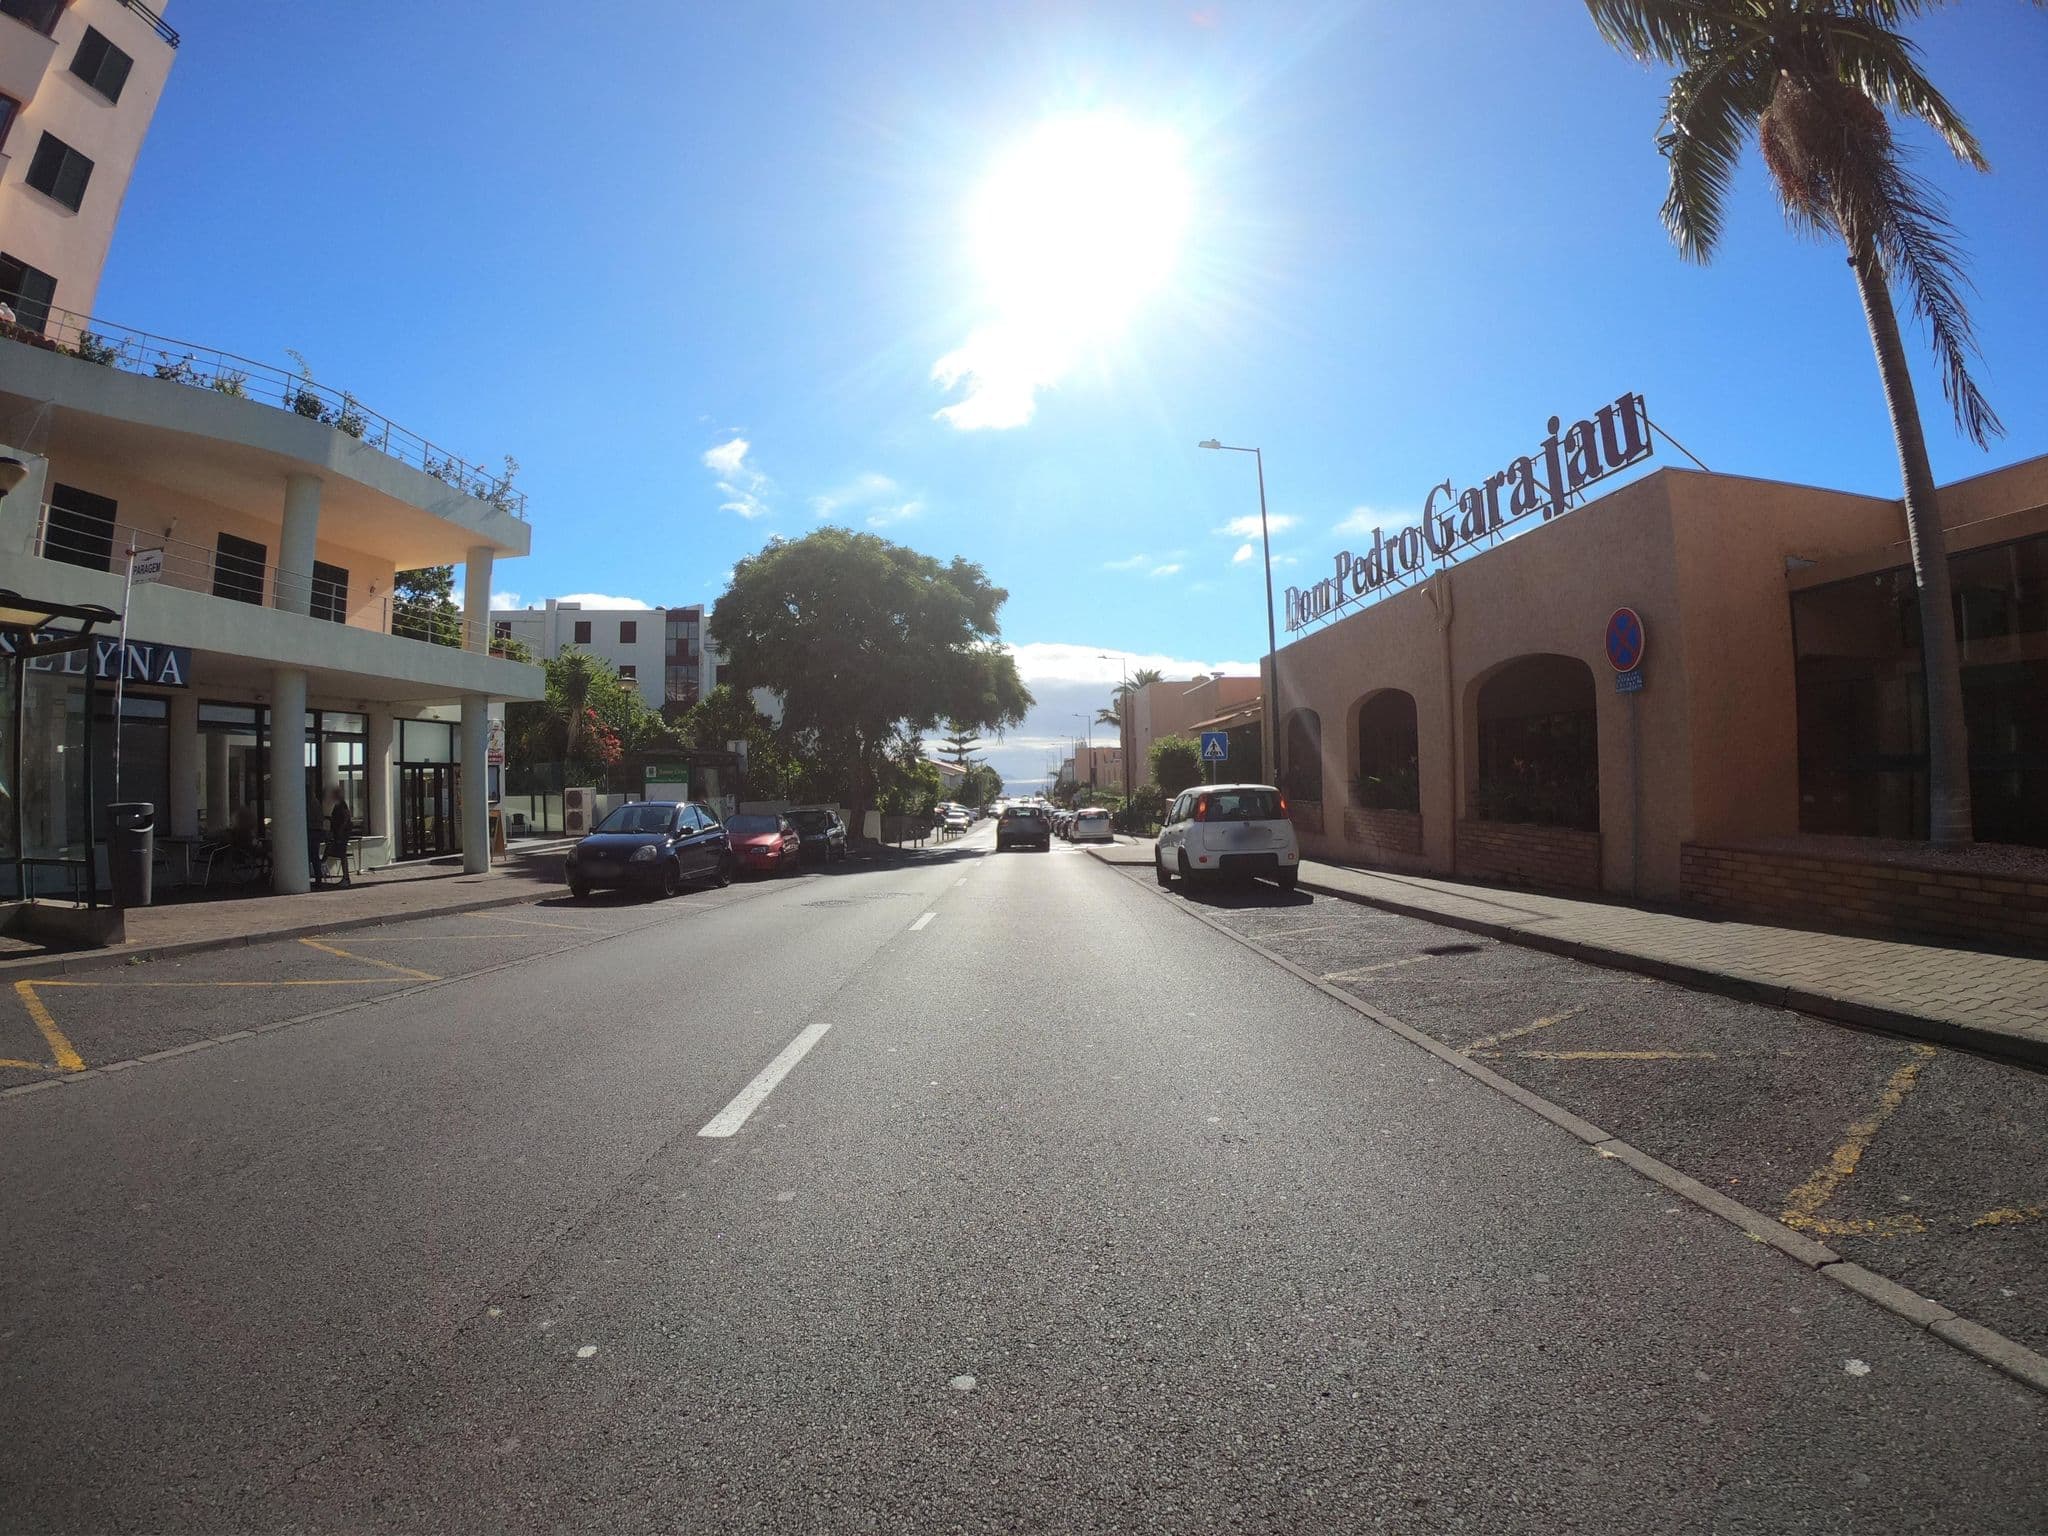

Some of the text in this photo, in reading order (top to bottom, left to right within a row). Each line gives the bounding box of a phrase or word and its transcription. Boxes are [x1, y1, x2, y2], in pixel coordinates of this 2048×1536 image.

[1284, 391, 1650, 632] Dom Pedro Garajau
